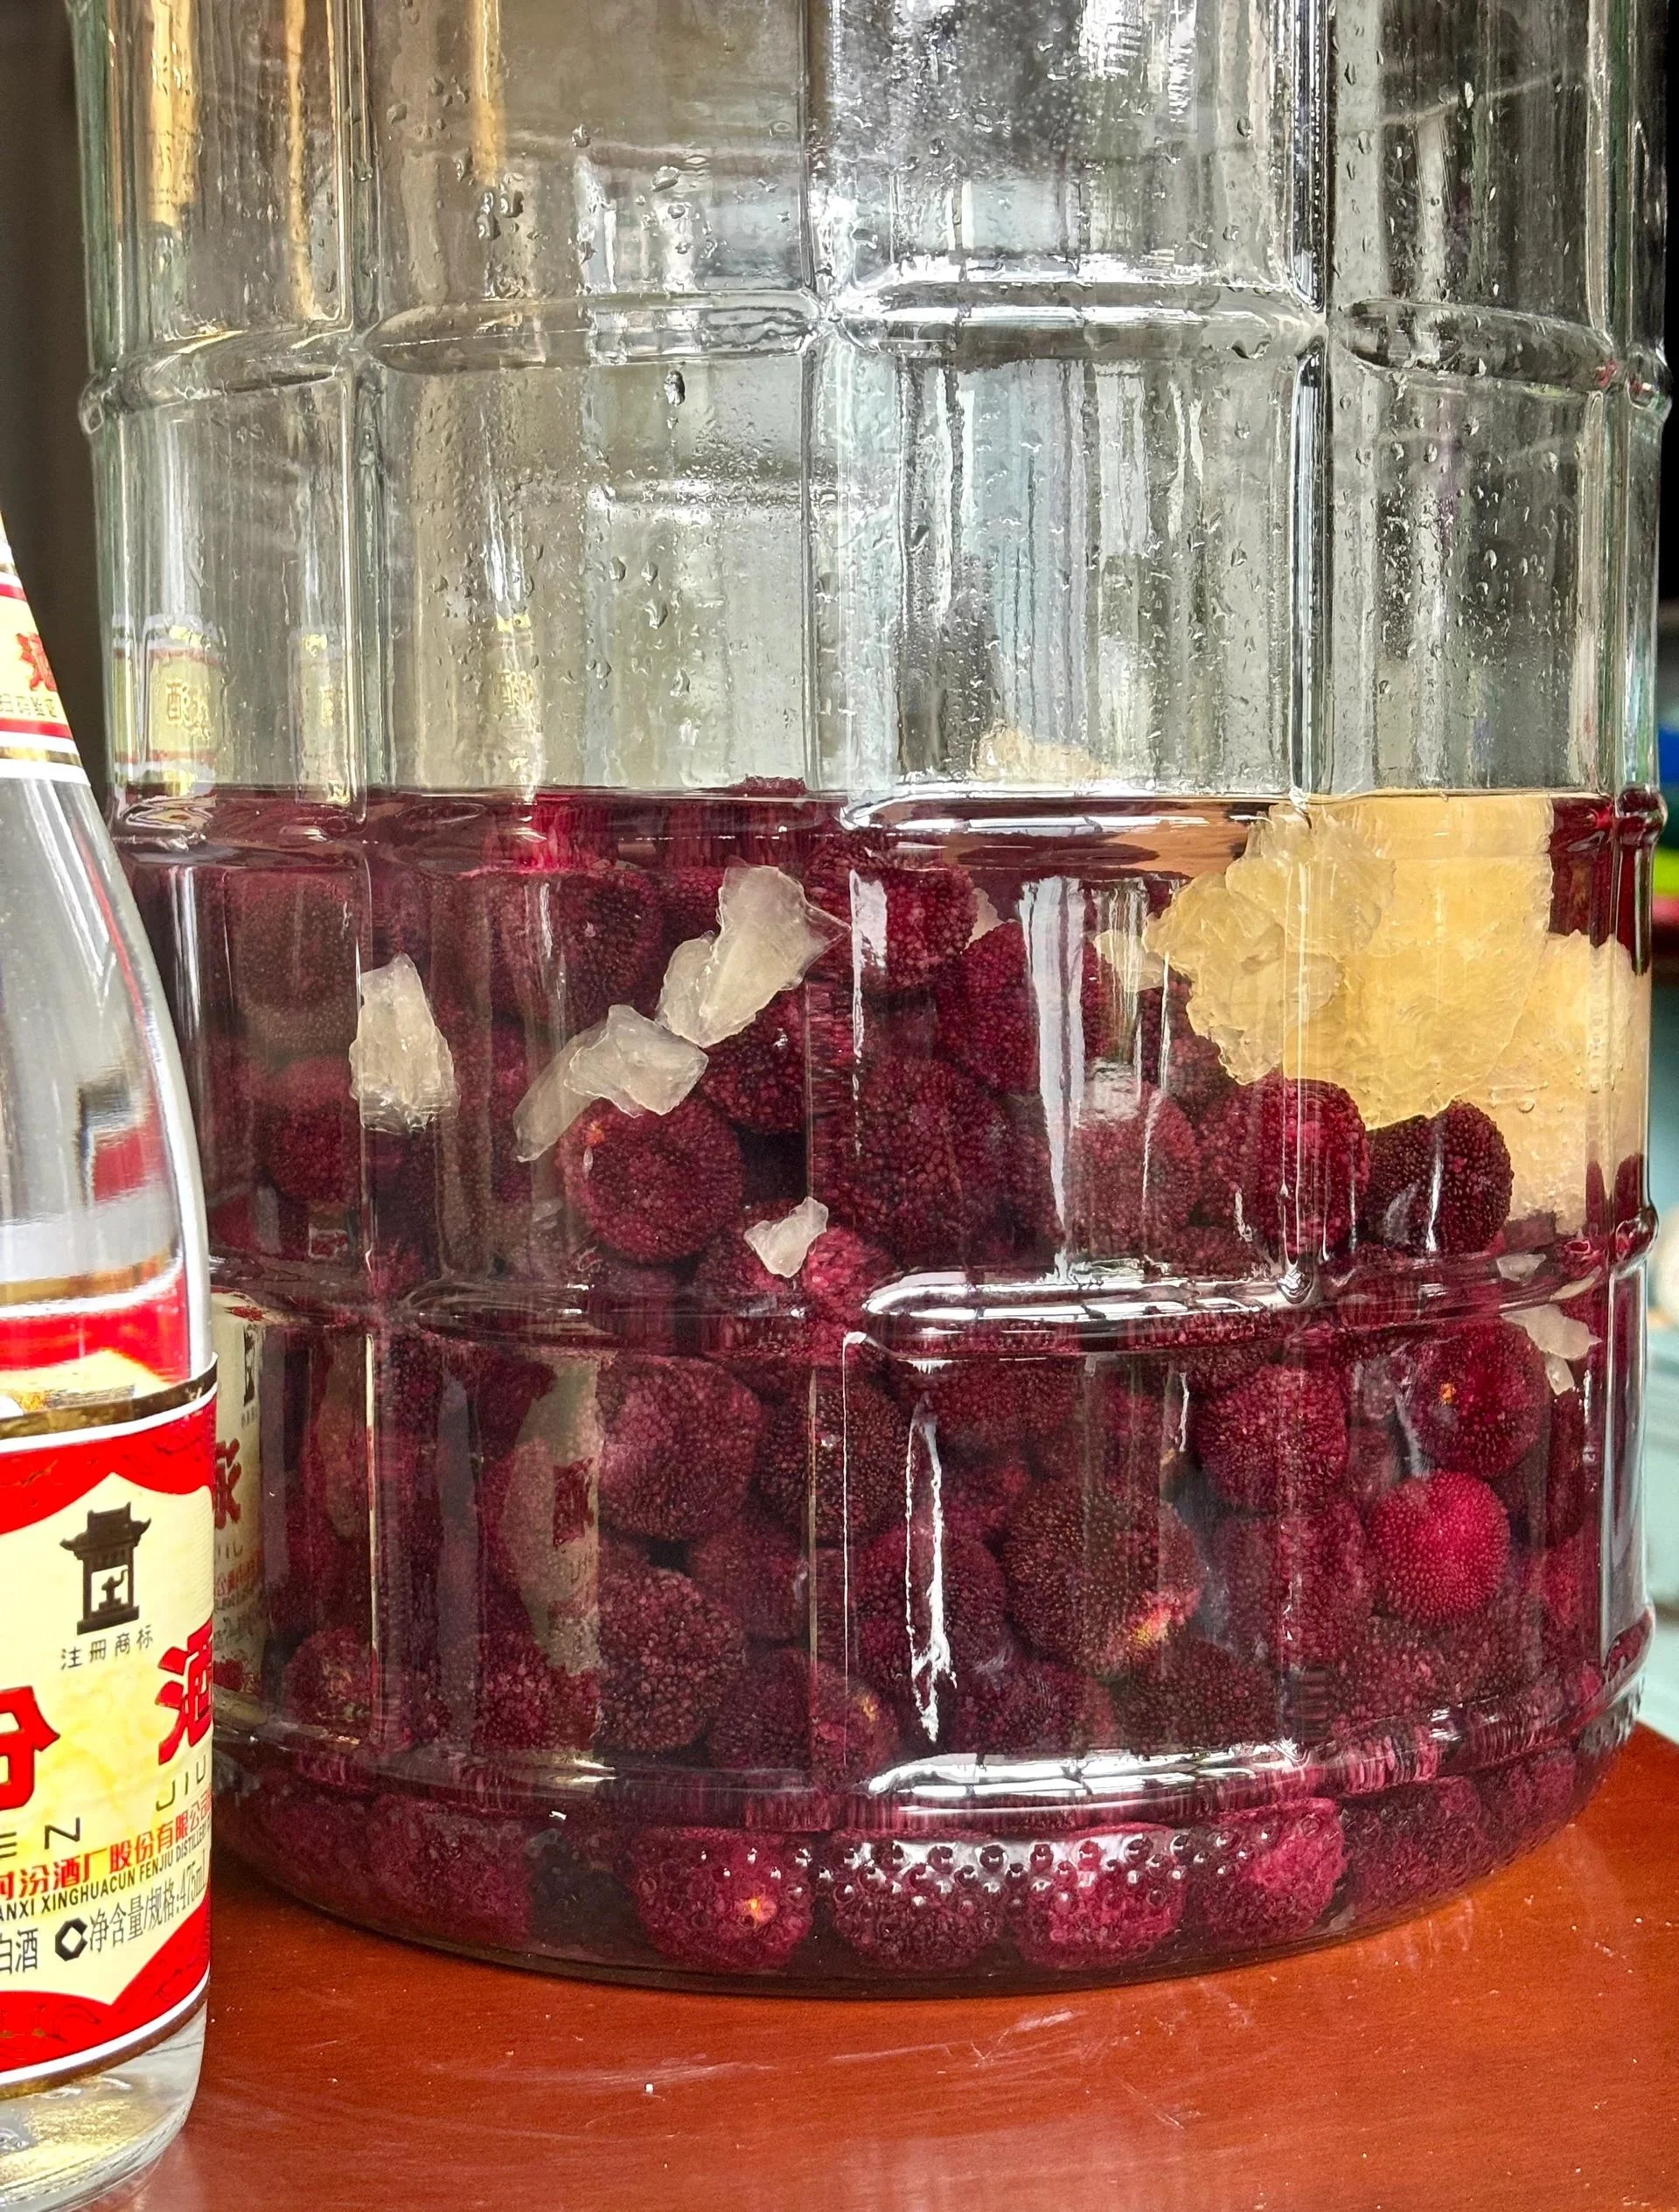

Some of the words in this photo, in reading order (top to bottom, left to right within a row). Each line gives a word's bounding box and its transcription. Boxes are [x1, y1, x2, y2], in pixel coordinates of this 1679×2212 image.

[156, 1755, 206, 1812] JIU
[41, 1867, 136, 1915] XINGHUACUN
[139, 1848, 173, 1882] FENJIU
